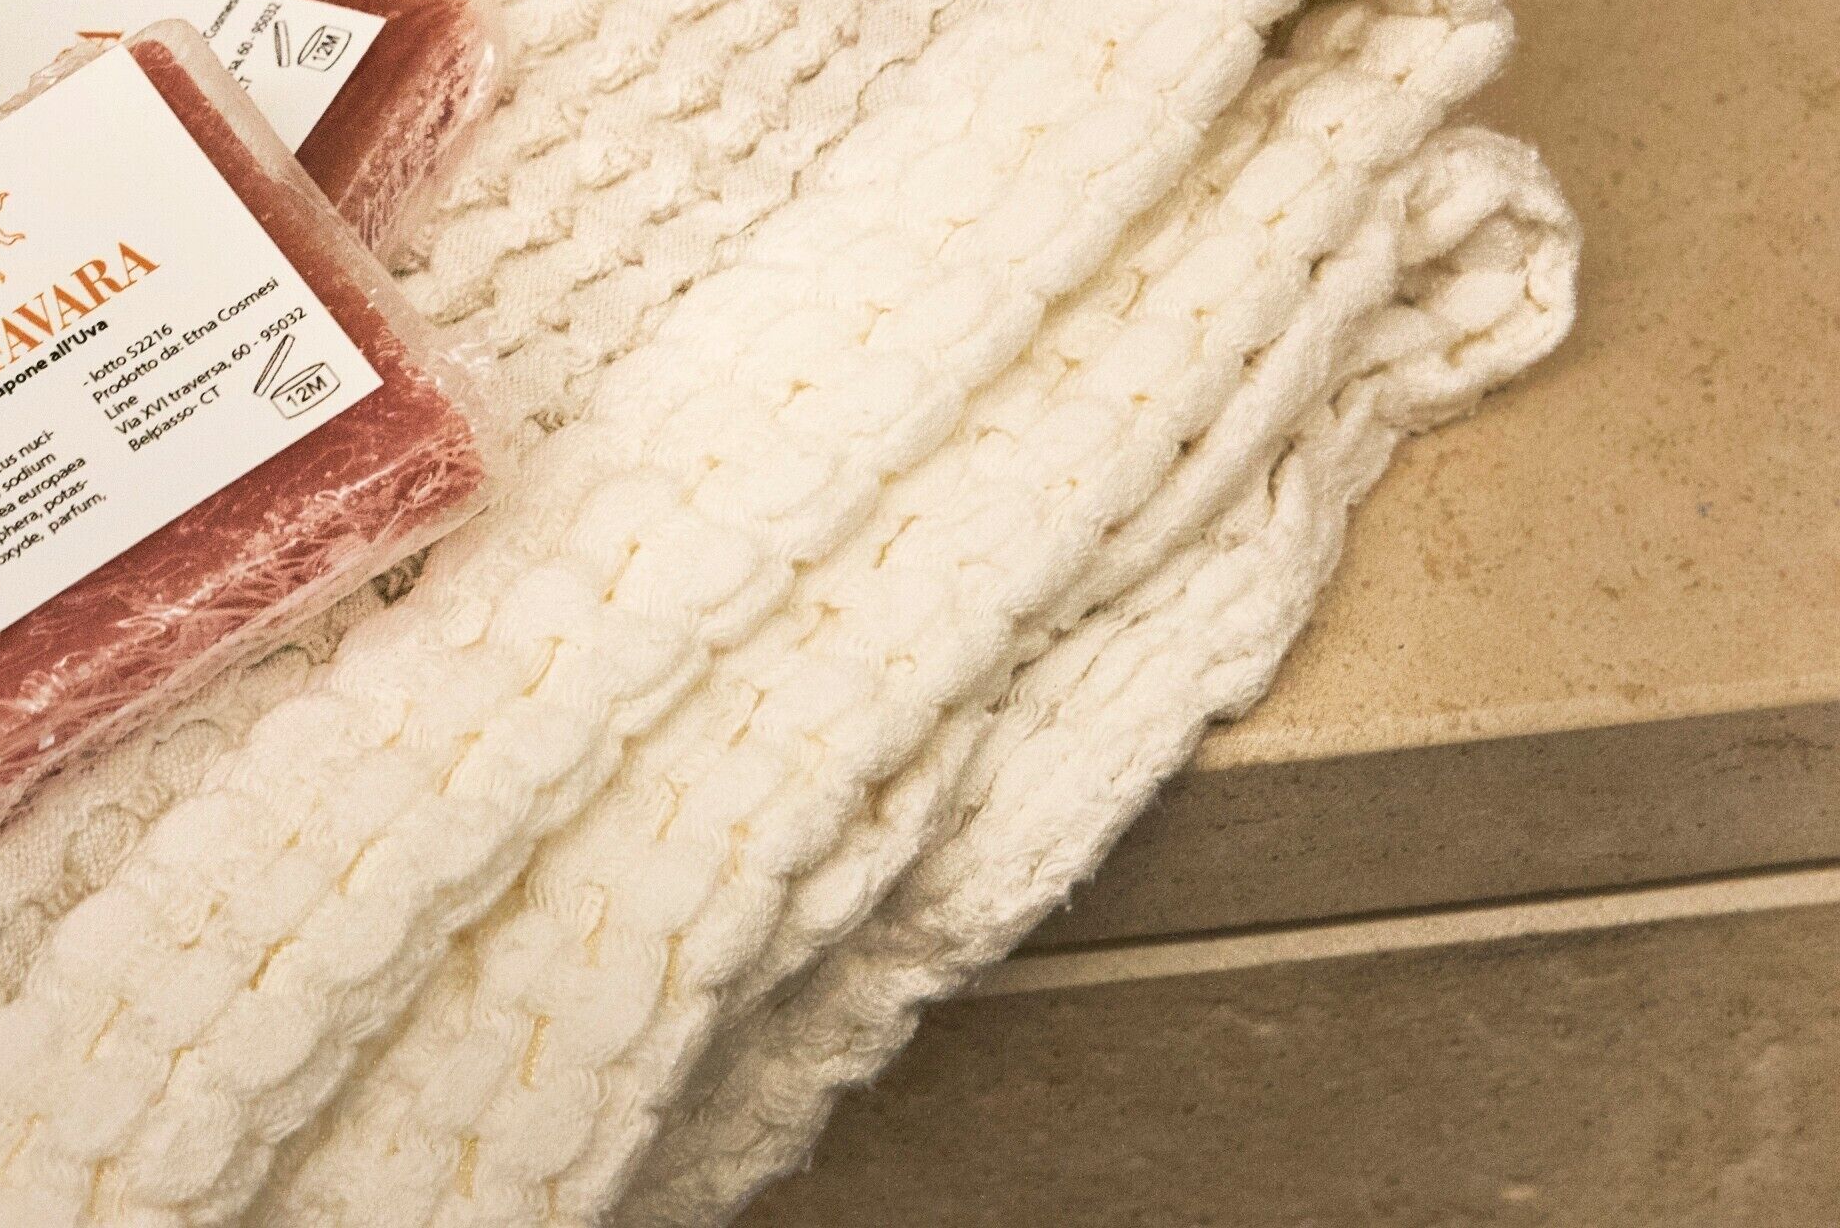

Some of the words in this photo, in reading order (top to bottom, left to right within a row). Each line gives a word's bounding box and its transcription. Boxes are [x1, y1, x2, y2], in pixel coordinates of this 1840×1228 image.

[312, 34, 341, 61] 12M
[49, 320, 109, 362] all'Uva
[93, 359, 159, 405] Prodotto
[160, 343, 185, 362] da:
[182, 321, 218, 346] Etna
[217, 276, 280, 323] Cosmesi
[89, 356, 127, 383] lotto
[114, 415, 142, 436] Via
[141, 396, 169, 420] XVI
[168, 360, 232, 403] traversa,
[232, 343, 252, 362] 60
[260, 306, 308, 342] 95032
[104, 394, 139, 420] Line
[199, 384, 222, 406] CT
[286, 375, 328, 408] 12M
[19, 430, 54, 458] nuci-
[2, 453, 56, 492] sodium
[18, 457, 86, 505] europaea
[43, 479, 88, 514] potas-
[47, 493, 107, 534] parfum,
